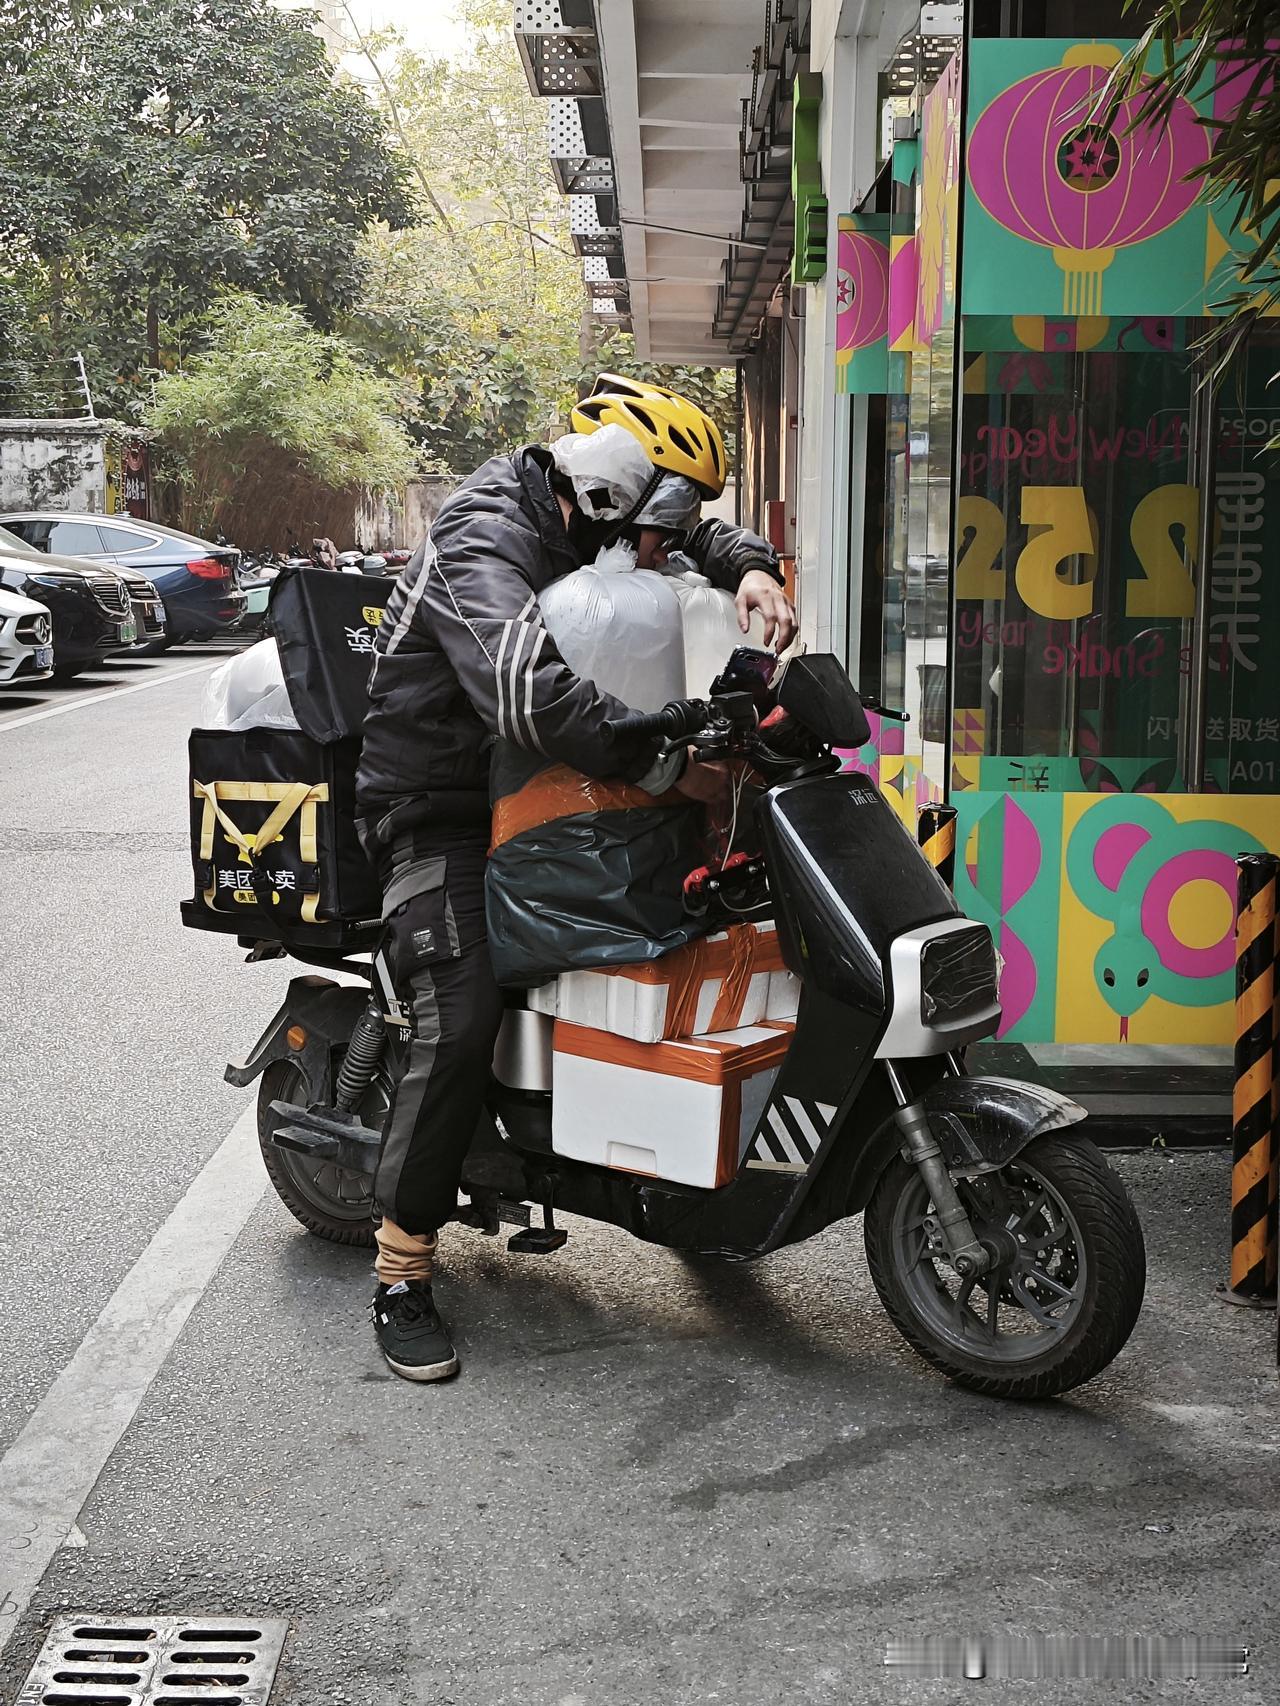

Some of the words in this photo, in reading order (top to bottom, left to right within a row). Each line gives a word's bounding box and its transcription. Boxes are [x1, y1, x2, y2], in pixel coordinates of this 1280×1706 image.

[1147, 716, 1280, 742] 闪送取货
[218, 869, 296, 890] 美团卖
